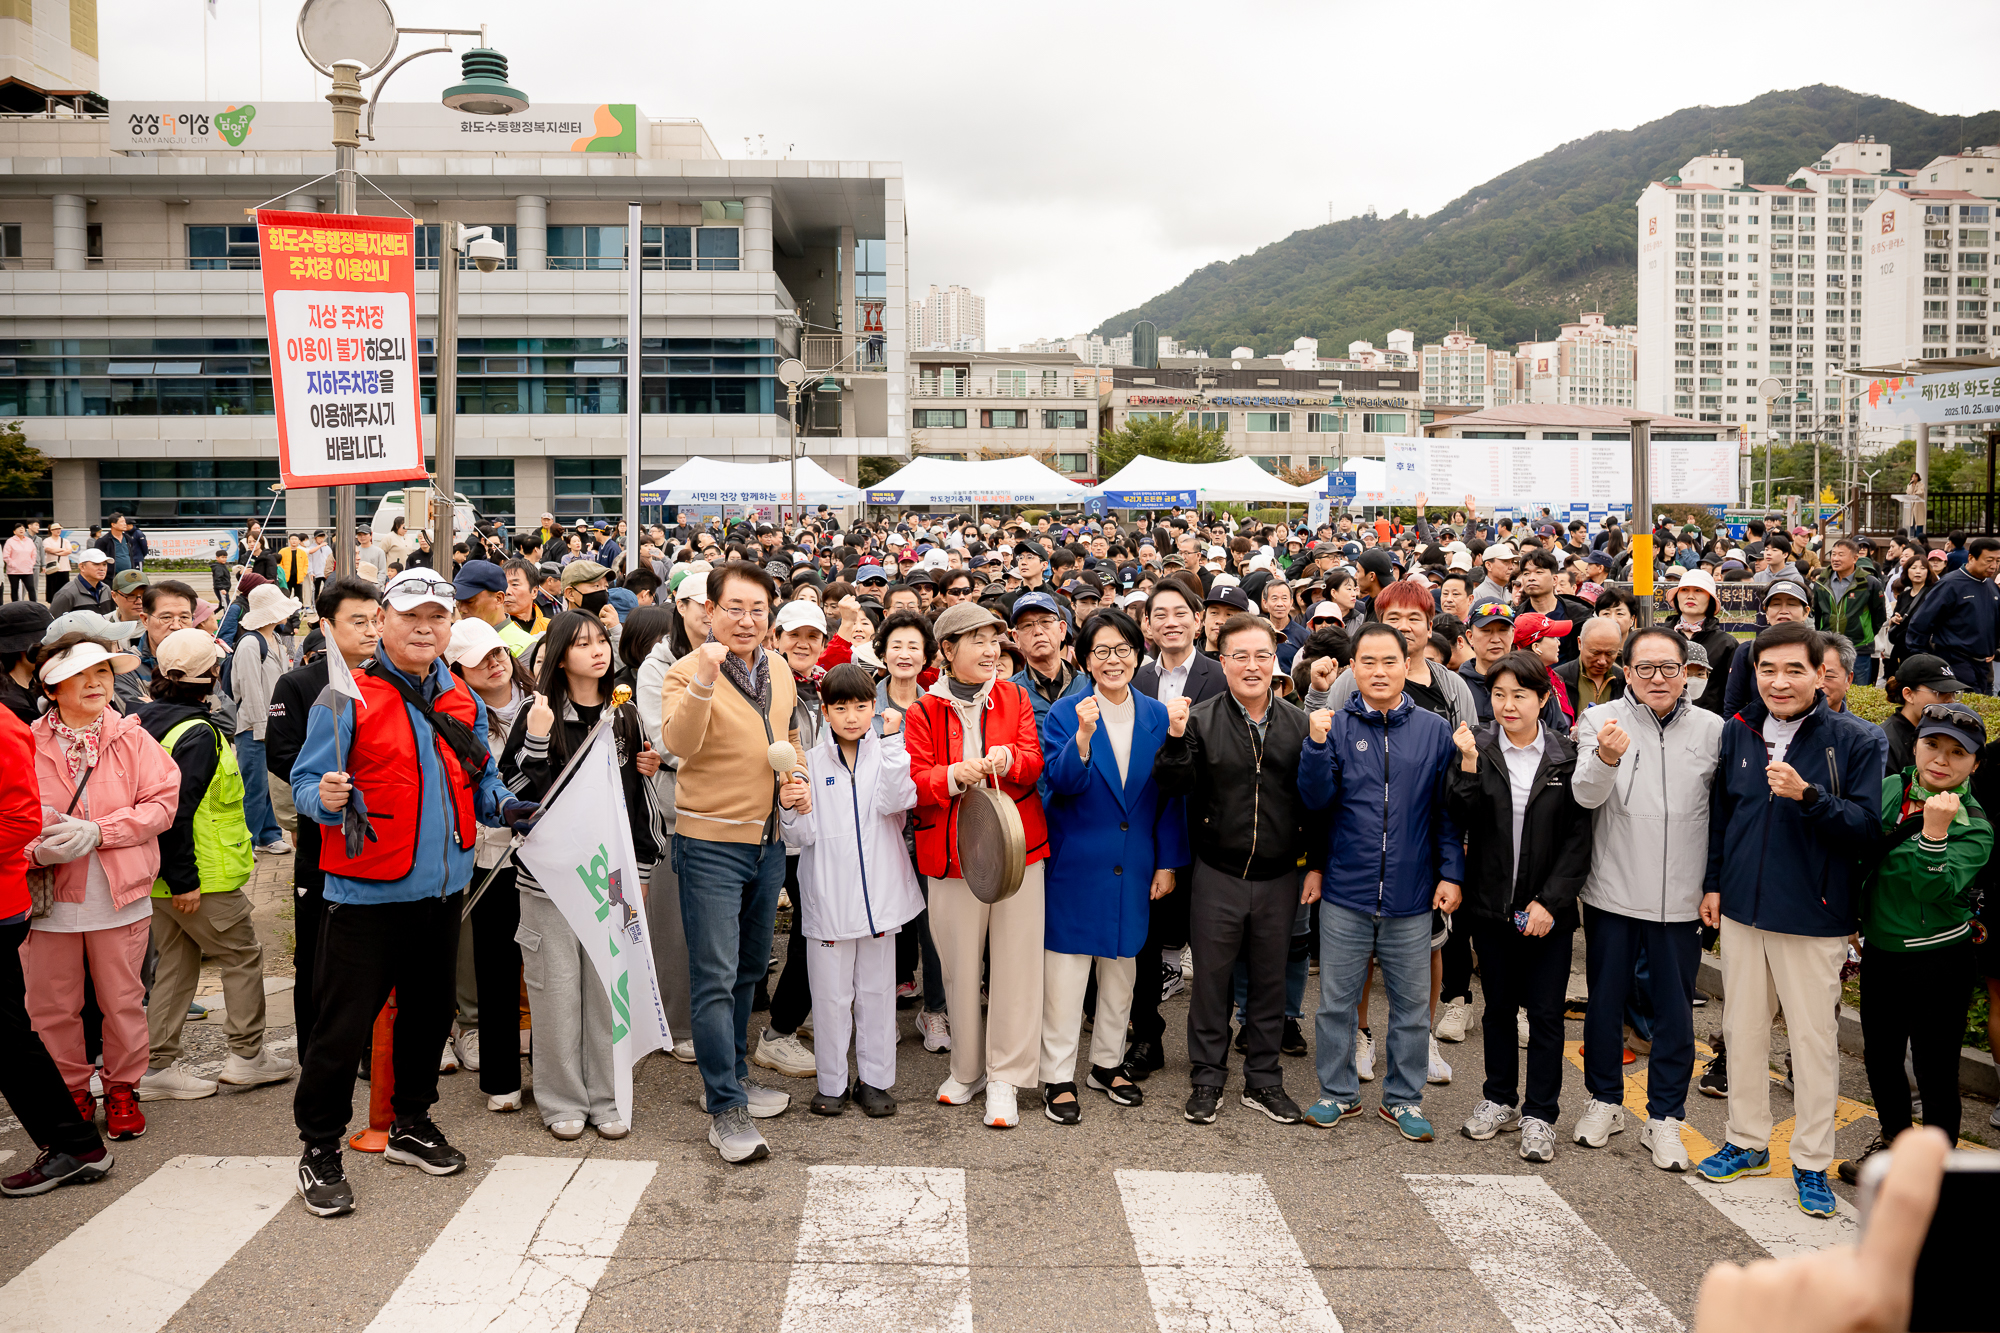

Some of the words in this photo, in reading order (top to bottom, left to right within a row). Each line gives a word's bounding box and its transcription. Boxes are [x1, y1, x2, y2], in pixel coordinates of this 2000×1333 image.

[219, 115, 248, 138] 남양주
[460, 121, 582, 133] 화도수동행정복지센터
[268, 227, 409, 256] 화도수동행정복지센터
[289, 256, 333, 280] 주차장
[335, 258, 390, 282] 이용안내
[1880, 262, 1894, 275] 102
[308, 304, 337, 329] 지상
[341, 305, 384, 330] 주차장
[287, 337, 333, 362] 이용이
[336, 337, 406, 362] 불가하오니
[306, 369, 394, 395] 지하주차장을
[1921, 381, 1960, 401] 제12회
[1360, 397, 1384, 407] Park
[310, 402, 395, 428] 이용해주시기
[326, 434, 387, 461] 바랍니다.
[1336, 477, 1344, 486] P
[691, 492, 717, 501] 시민의
[720, 492, 737, 501] 건강
[740, 492, 777, 501] 함께하는
[930, 495, 972, 503] 화도걷기축제
[1220, 587, 1232, 598] F
